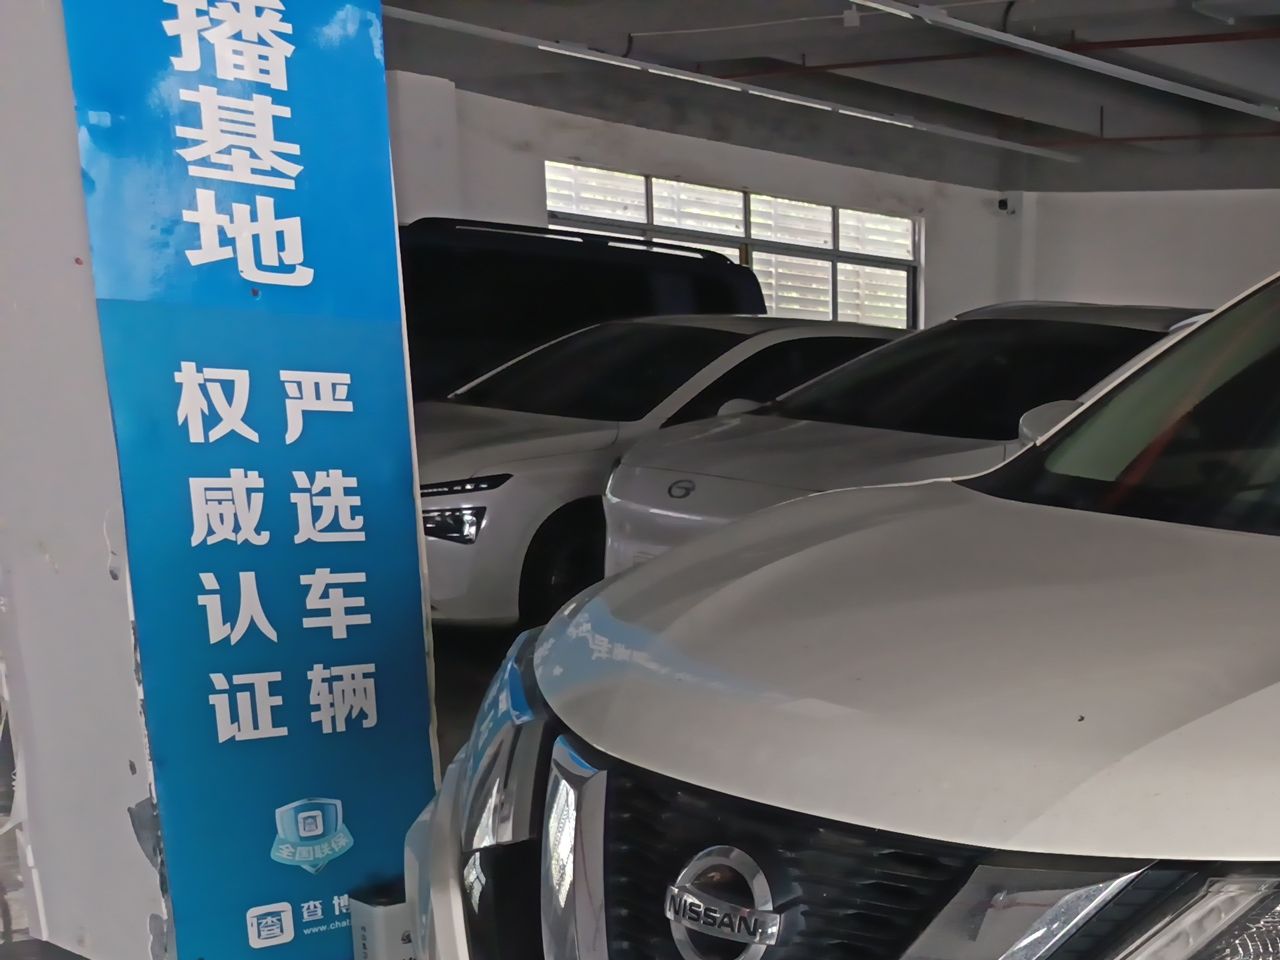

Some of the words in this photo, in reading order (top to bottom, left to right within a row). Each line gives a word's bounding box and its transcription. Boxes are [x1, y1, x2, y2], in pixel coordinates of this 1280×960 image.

[162, 0, 314, 286] 播基地
[174, 361, 289, 743] 权威认证
[279, 369, 378, 734] 严选车辆
[276, 831, 350, 861] 全国联保
[668, 894, 759, 936] NISSAN
